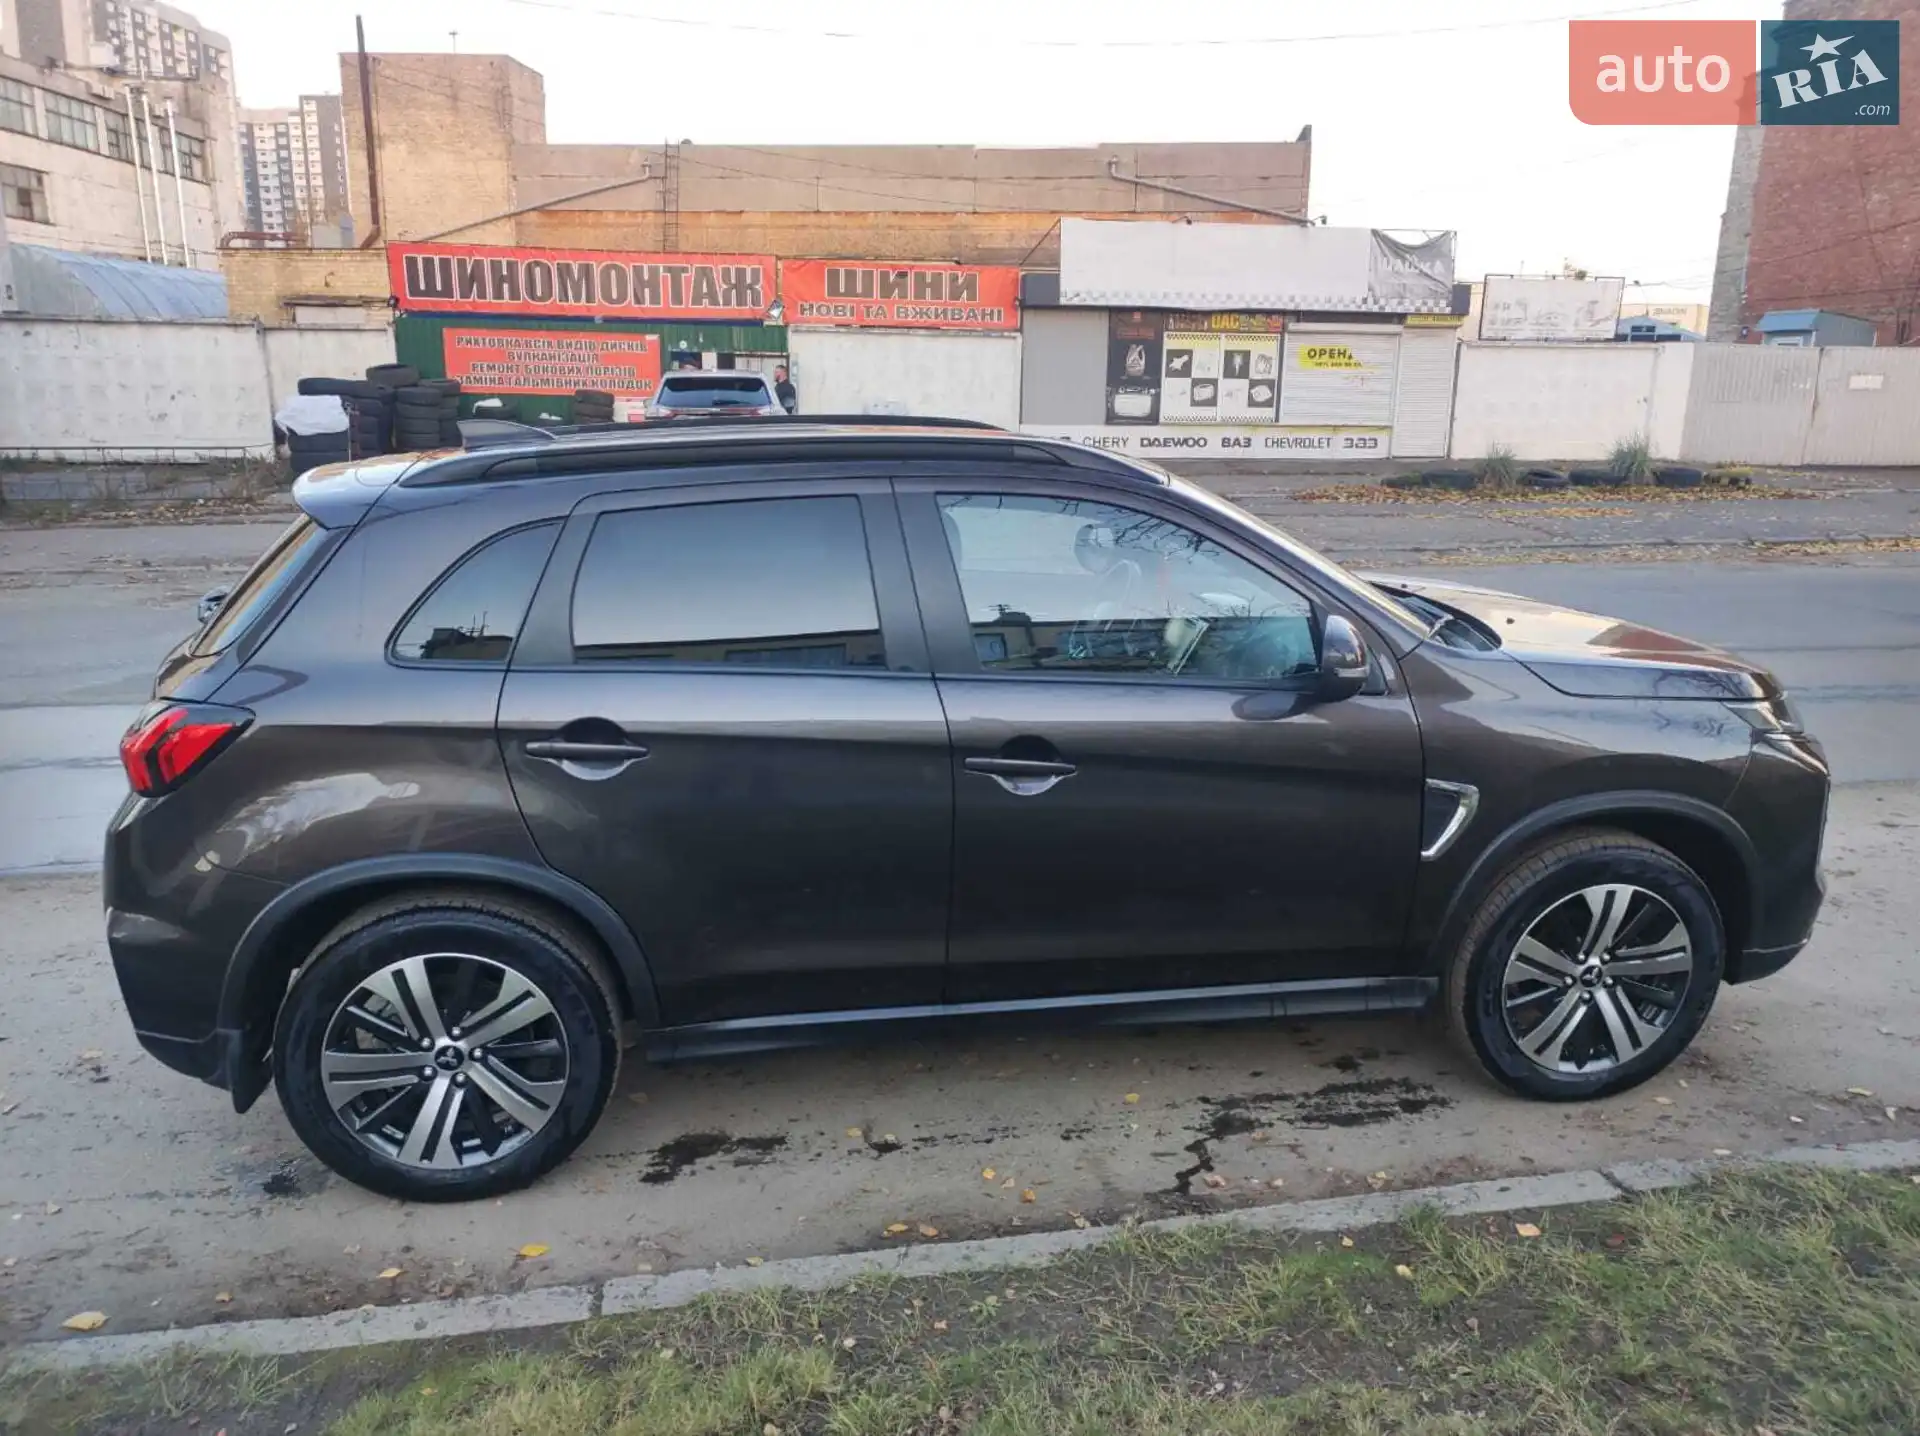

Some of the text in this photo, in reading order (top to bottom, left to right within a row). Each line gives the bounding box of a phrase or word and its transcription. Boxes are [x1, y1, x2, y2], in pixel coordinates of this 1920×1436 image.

[403, 253, 765, 309] ШИНОМОНТАЖ
[825, 267, 980, 303] ШИНИ
[799, 303, 1004, 322] НОВІ ТА ВЖИВАНІ
[506, 350, 599, 364] ВУЛКАНІЗАЦІЯ
[471, 362, 520, 374] РЕМОНТ
[524, 363, 583, 377] БОКОВИХ
[591, 379, 653, 391] КОЛОДОК
[1083, 436, 1129, 448] CHERY
[1140, 436, 1208, 448] DAEWOO
[1264, 437, 1333, 449] CHEVROLET
